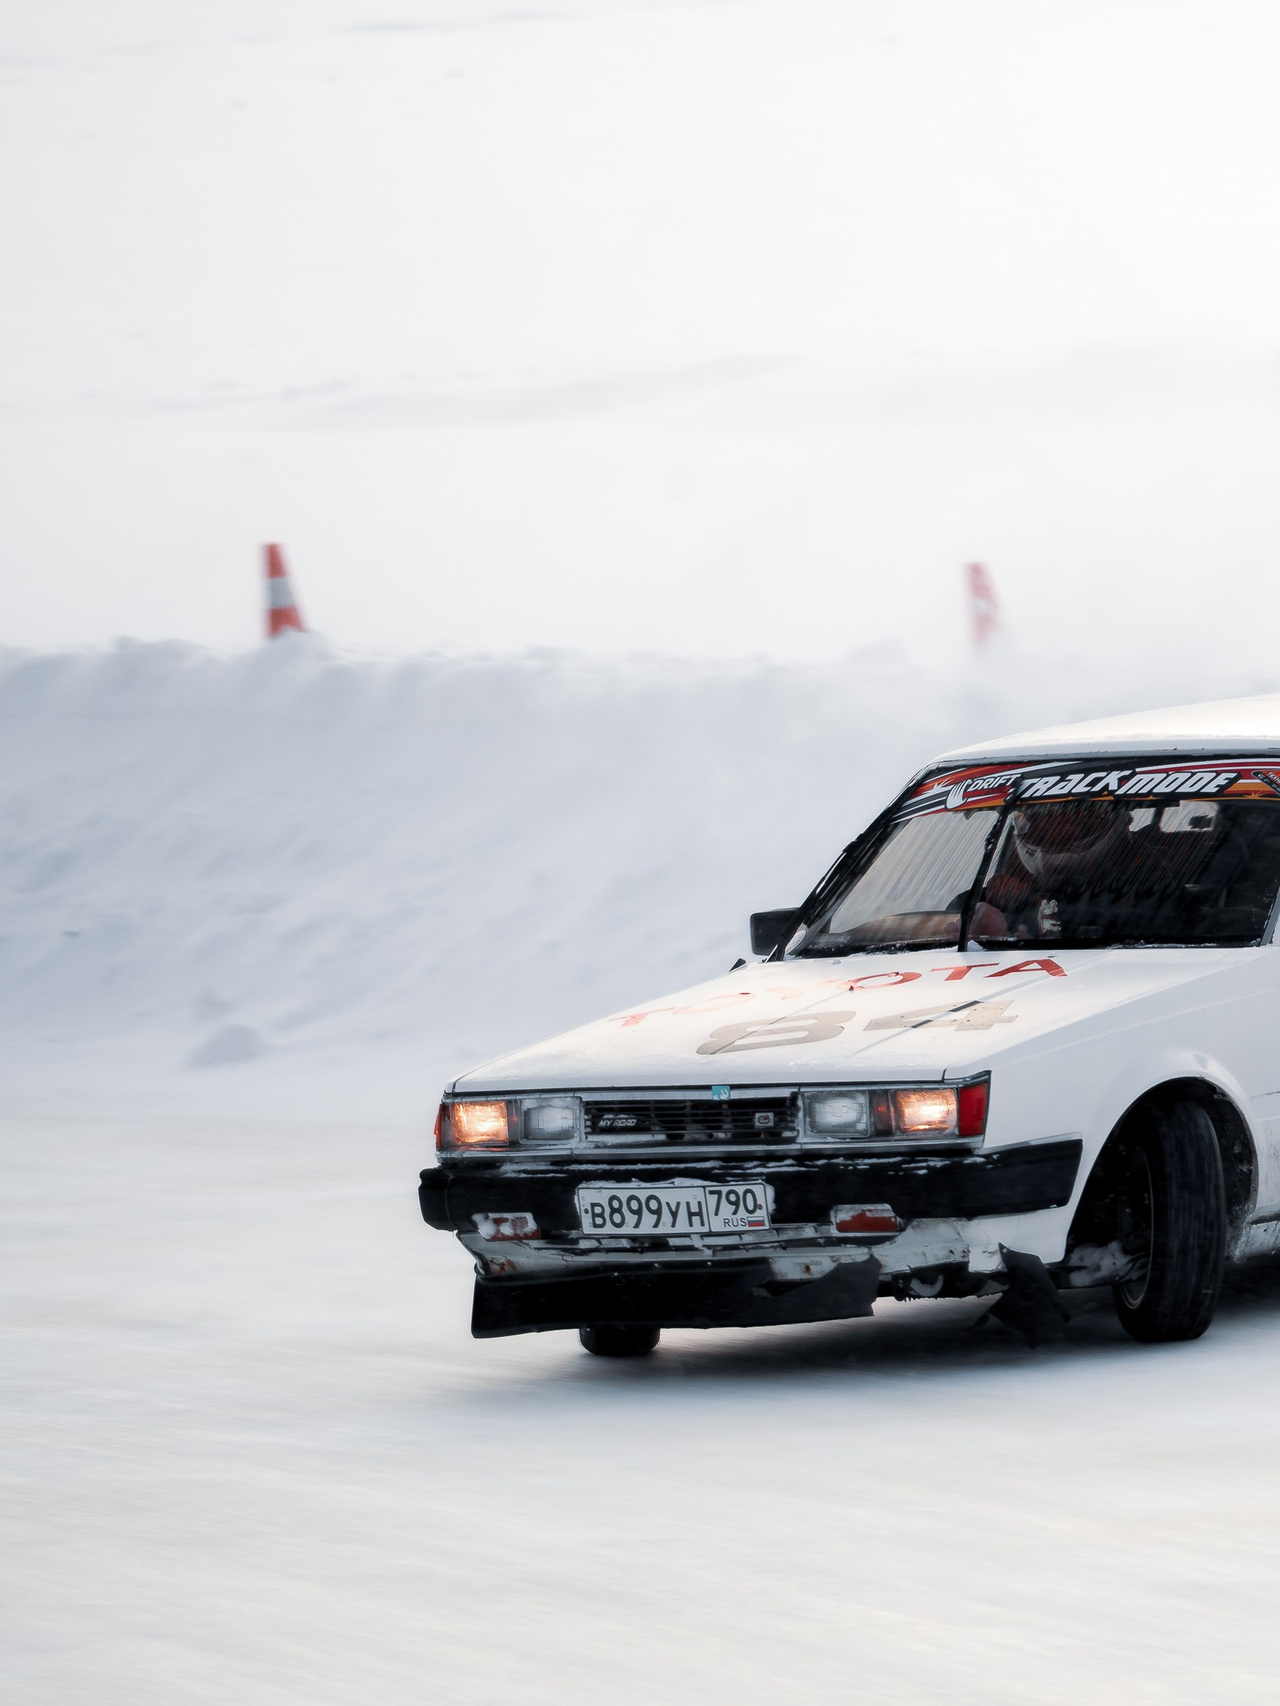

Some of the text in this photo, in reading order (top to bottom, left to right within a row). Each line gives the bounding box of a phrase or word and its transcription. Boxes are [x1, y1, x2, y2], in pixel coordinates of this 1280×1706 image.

[966, 773, 1023, 793] DRIFT
[609, 958, 1069, 1028] TOYOTA
[696, 1000, 1019, 1055] 84
[598, 1119, 637, 1127] MY ROAD
[708, 1188, 758, 1217] 790
[723, 1217, 747, 1228] RUS
